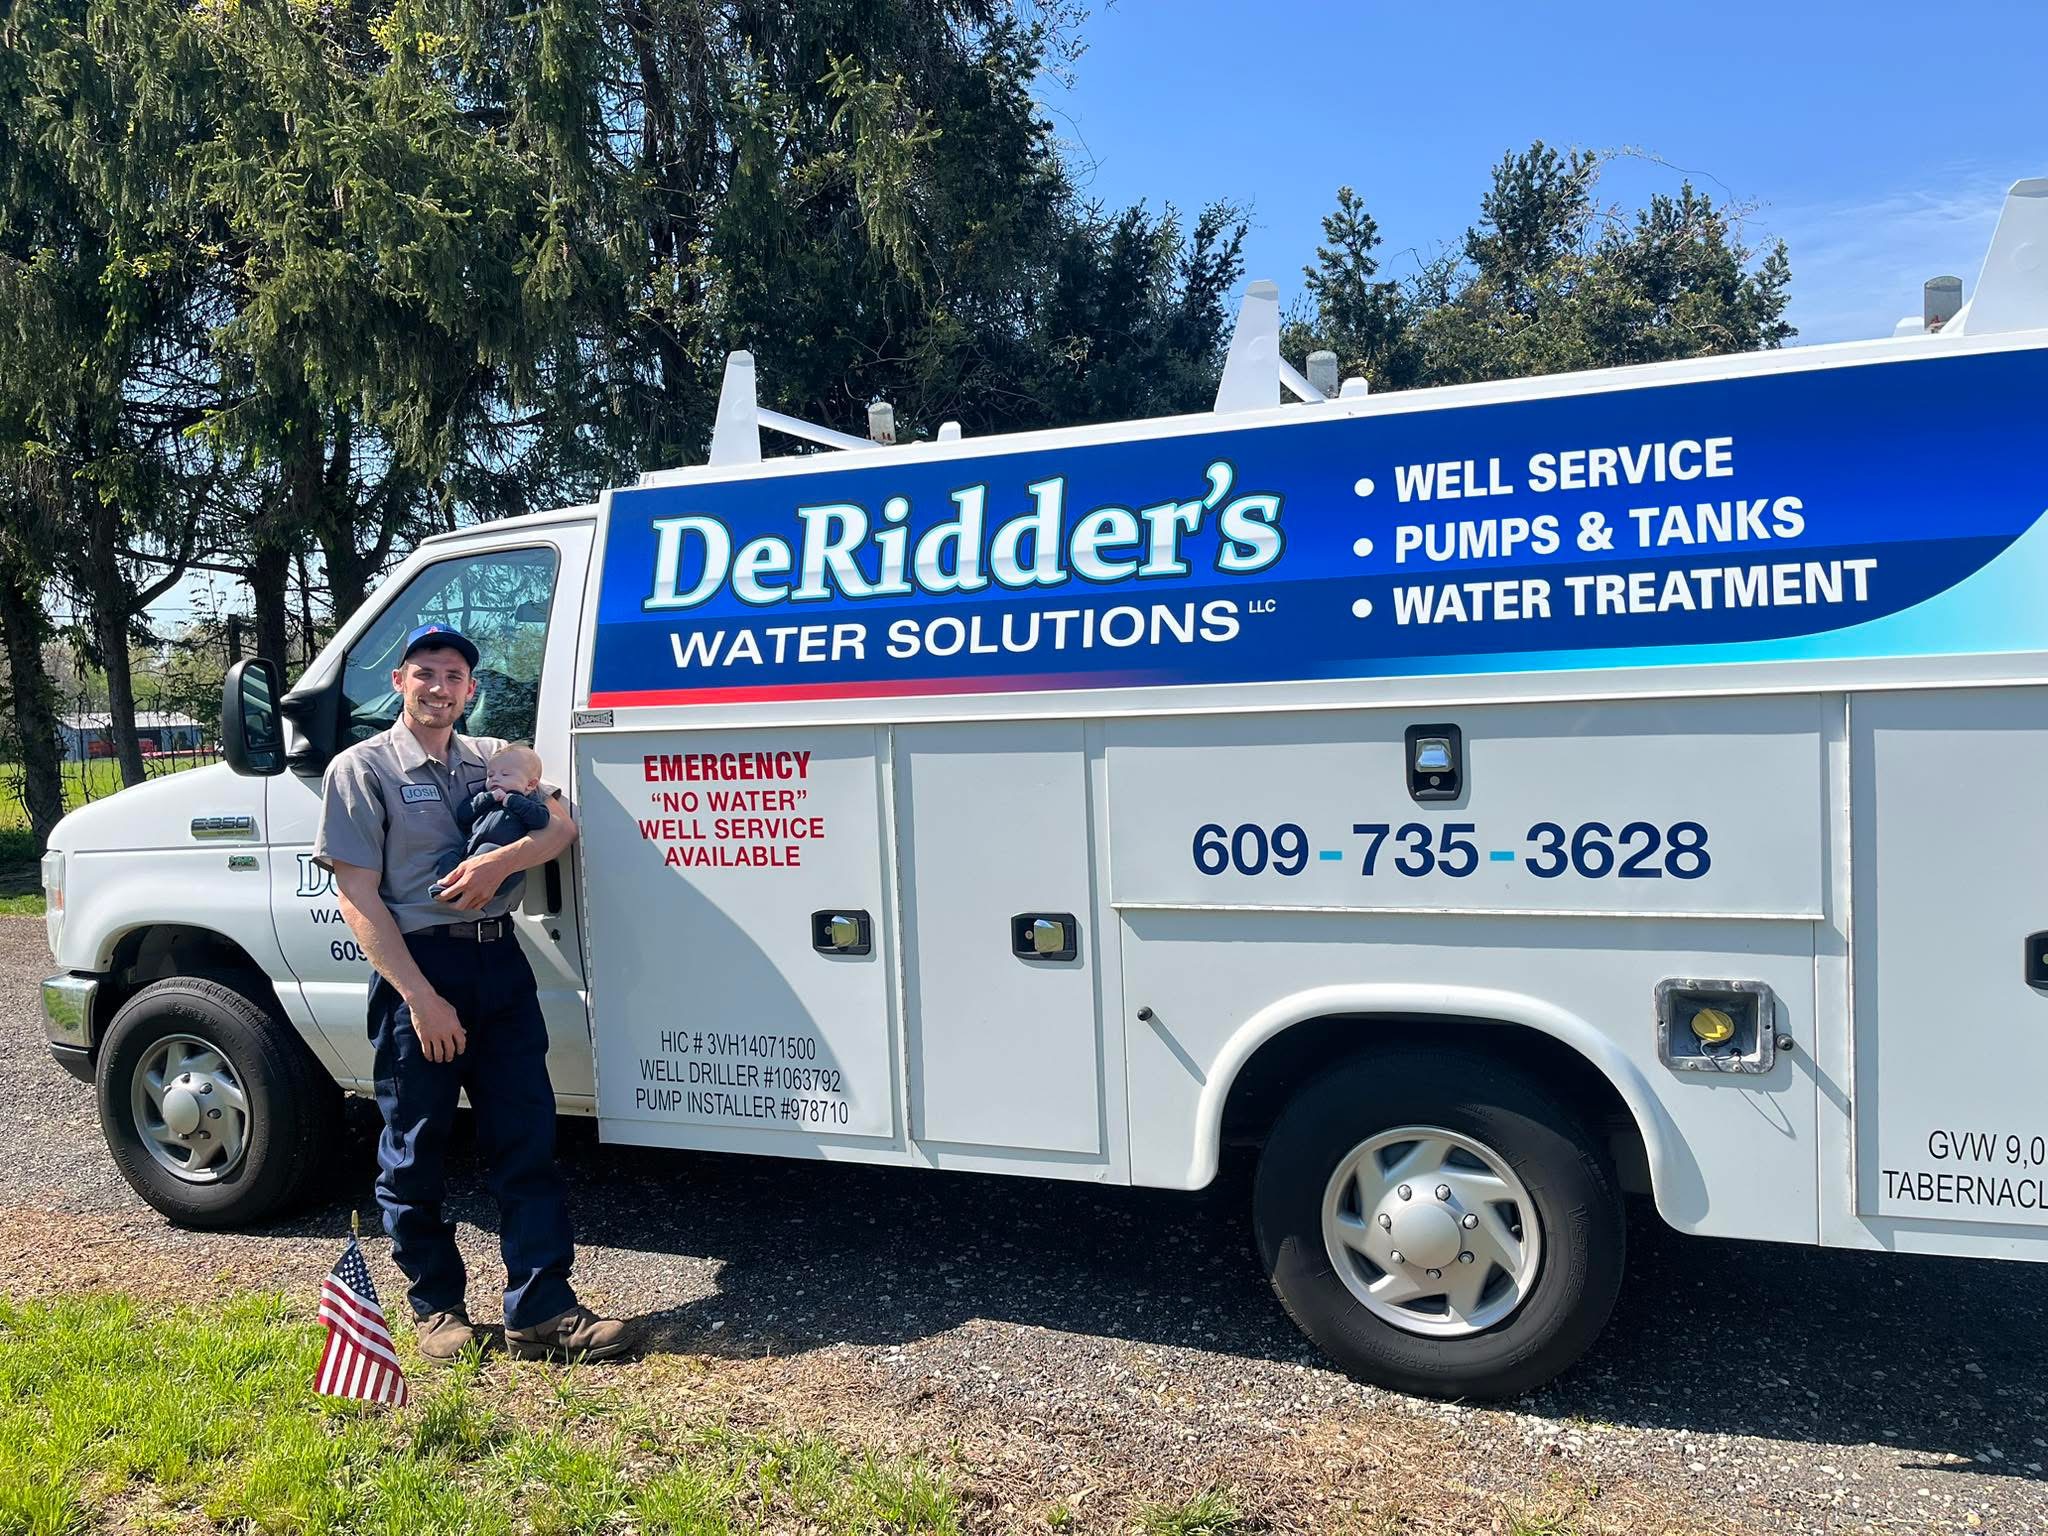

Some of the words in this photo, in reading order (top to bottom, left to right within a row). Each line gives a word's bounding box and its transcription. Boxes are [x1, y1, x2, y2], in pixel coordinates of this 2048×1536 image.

[1395, 458, 1513, 503] WELL
[1528, 437, 1734, 492] SERVICE
[642, 460, 1285, 612] DeRidder's
[1395, 515, 1560, 563] PUMPS
[1577, 511, 1614, 550] &
[1629, 496, 1805, 548] TANKS
[1393, 578, 1551, 625] WATER
[1564, 558, 1878, 616] TREATMENT
[669, 623, 867, 668] WATER
[886, 599, 1240, 659] SOLUTIONS
[1249, 598, 1276, 615] LLC
[643, 751, 811, 782] EMERGENCY
[405, 787, 438, 799] JOSH
[651, 791, 699, 812] “NO
[707, 789, 807, 812] WATER”
[638, 819, 706, 840] WELL
[714, 817, 825, 839] SERVICE
[664, 845, 801, 867] AVAILABLE
[1192, 821, 1711, 879] 609-735-3628
[296, 853, 339, 897] D
[661, 1031, 688, 1053] HIC
[693, 1032, 703, 1054] #
[707, 1033, 816, 1060] 3VH14071500
[640, 1059, 684, 1083] WELL
[690, 1061, 759, 1087] DRILLER
[764, 1065, 841, 1092] #1063792
[636, 1088, 682, 1112] PUMP
[687, 1091, 776, 1119] INSTALLER
[781, 1098, 849, 1124] #978710
[1928, 1130, 1997, 1162] GVW
